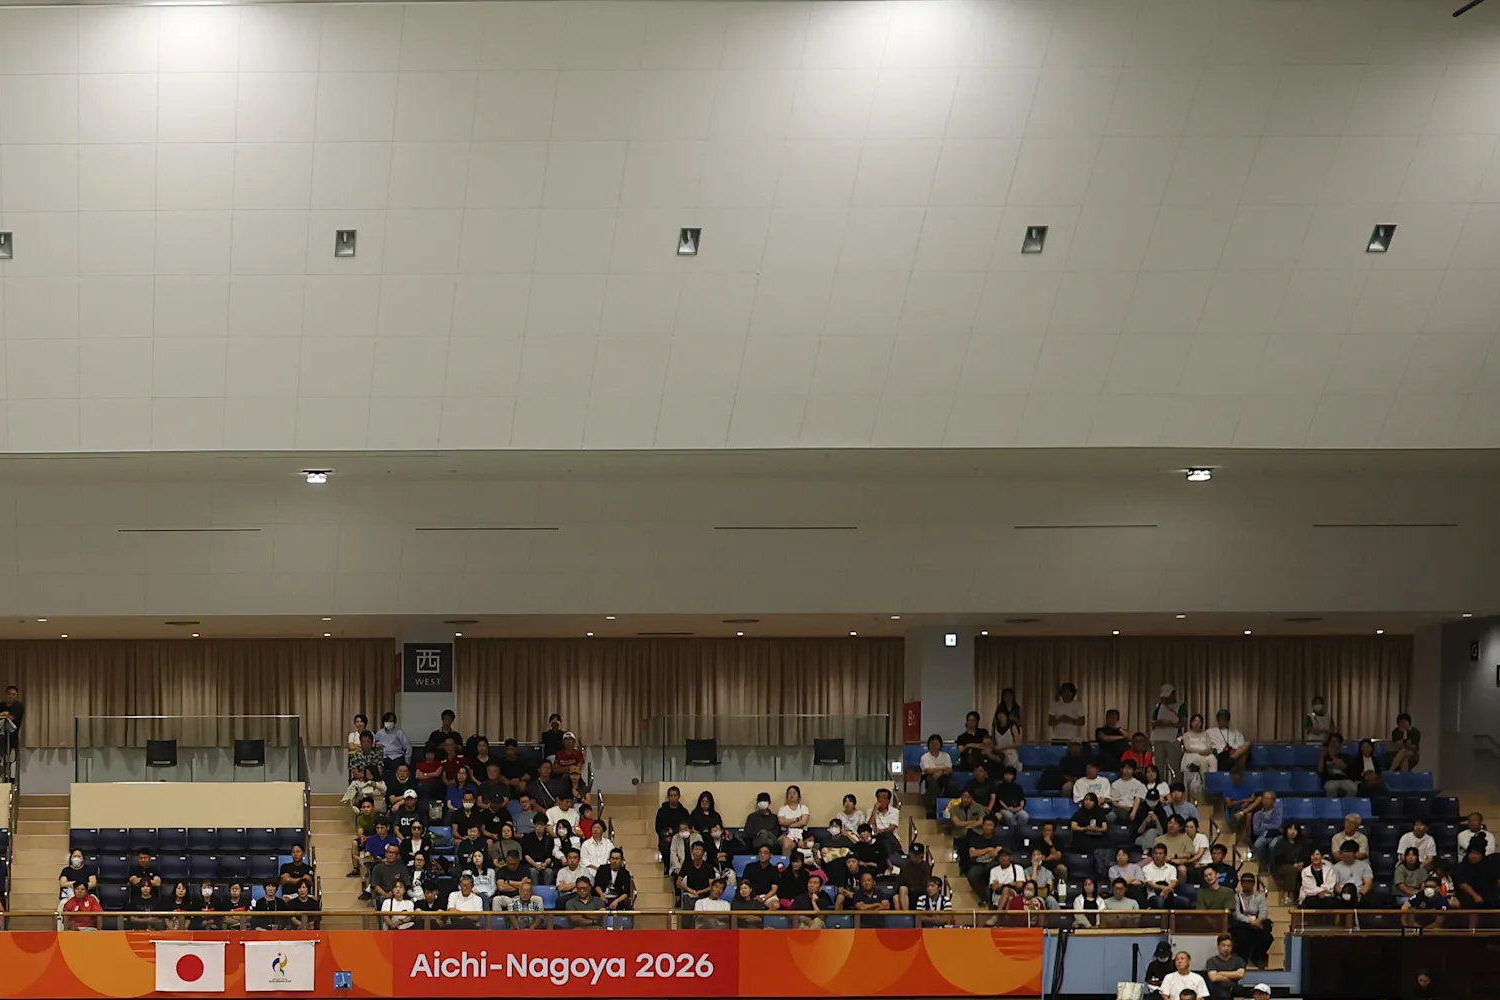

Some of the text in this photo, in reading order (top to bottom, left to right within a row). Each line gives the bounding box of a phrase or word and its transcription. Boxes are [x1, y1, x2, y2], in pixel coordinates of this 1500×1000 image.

[416, 649, 441, 673] 西
[414, 678, 441, 686] WEST
[410, 950, 714, 986] Aichi-Nagoya 2026
